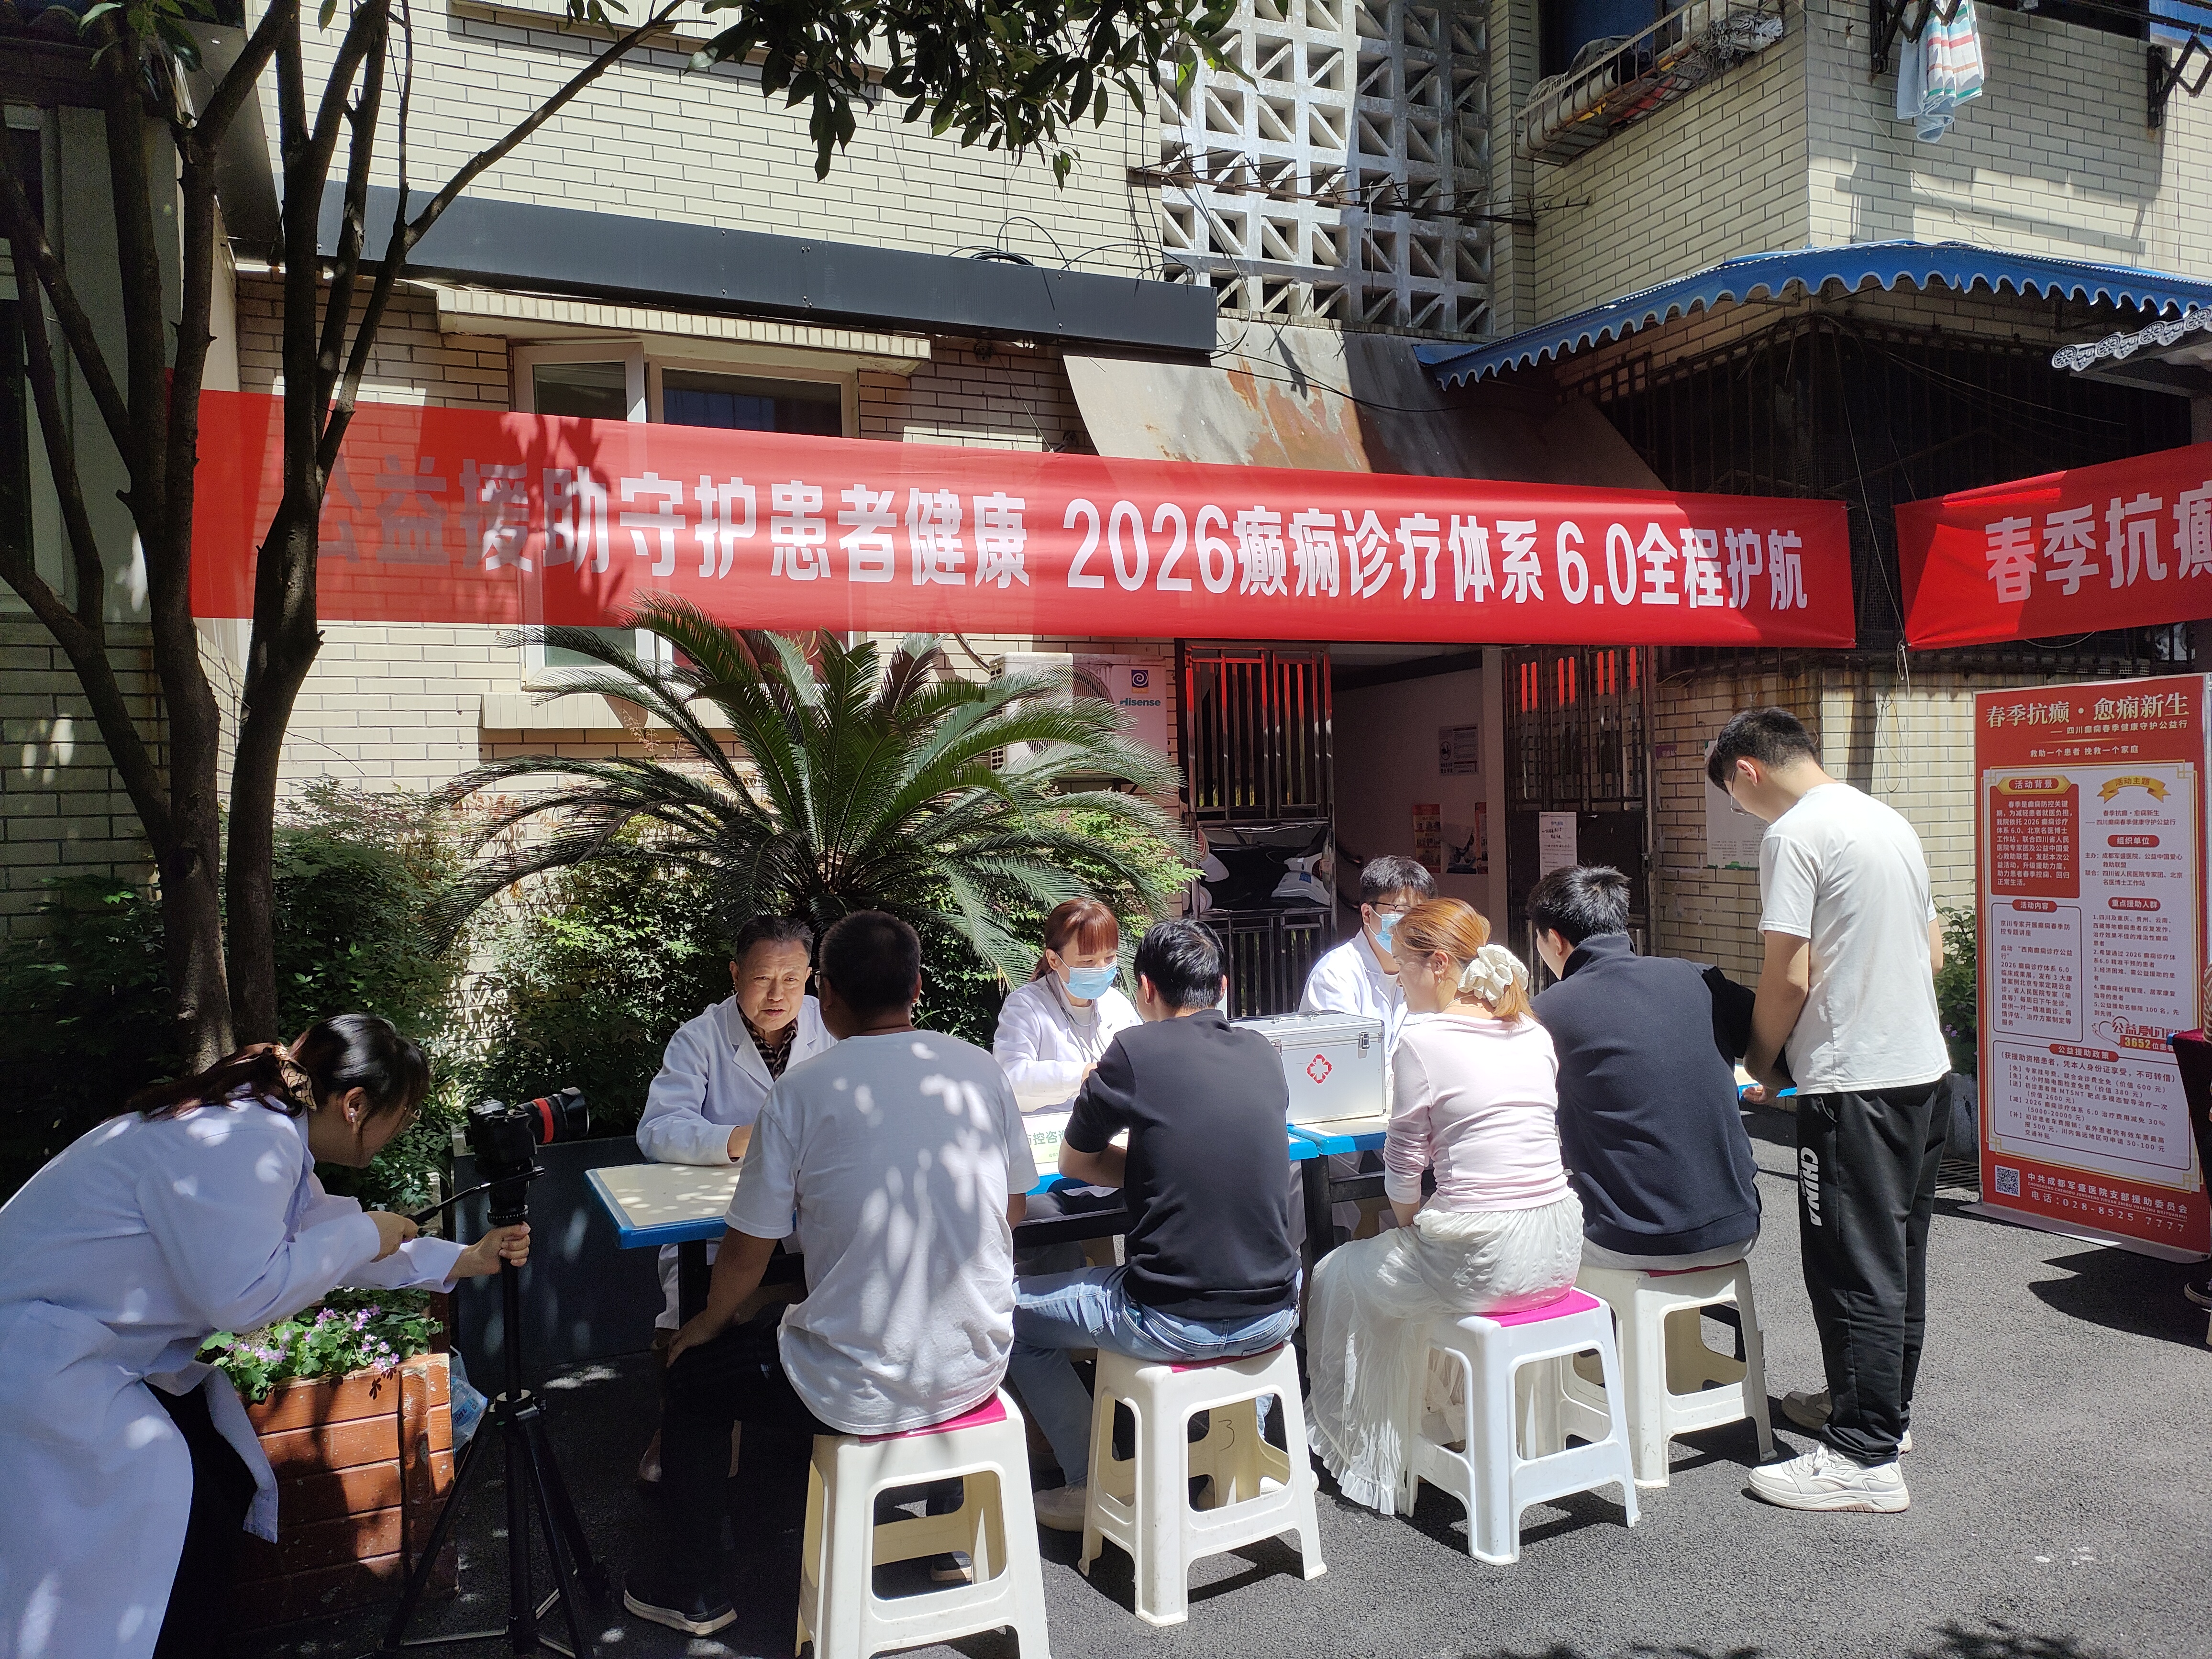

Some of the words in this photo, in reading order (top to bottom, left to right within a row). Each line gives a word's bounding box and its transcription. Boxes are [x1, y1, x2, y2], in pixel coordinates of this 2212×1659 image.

[2030, 748, 2080, 758] 救助一个患者
[2084, 745, 2139, 755] 挽救一个家庭
[2015, 779, 2053, 789] 活动背景
[2115, 777, 2150, 786] 活动主题
[2117, 837, 2149, 845] 组织单位
[2020, 902, 2048, 910] 活动内容
[2112, 899, 2157, 908] 重点援助人群
[2125, 1037, 2151, 1049] 3652
[2058, 1046, 2109, 1060] 公益援助政策
[2025, 1129, 2050, 1139] 交通补贴
[2033, 1123, 2046, 1131] 500
[2127, 1140, 2154, 1150] 50-100
[1801, 1147, 1823, 1226] CHINA
[2027, 1172, 2188, 1214] 中共成都军盛医院支部援助委员会
[1218, 1420, 1234, 1451] 3
